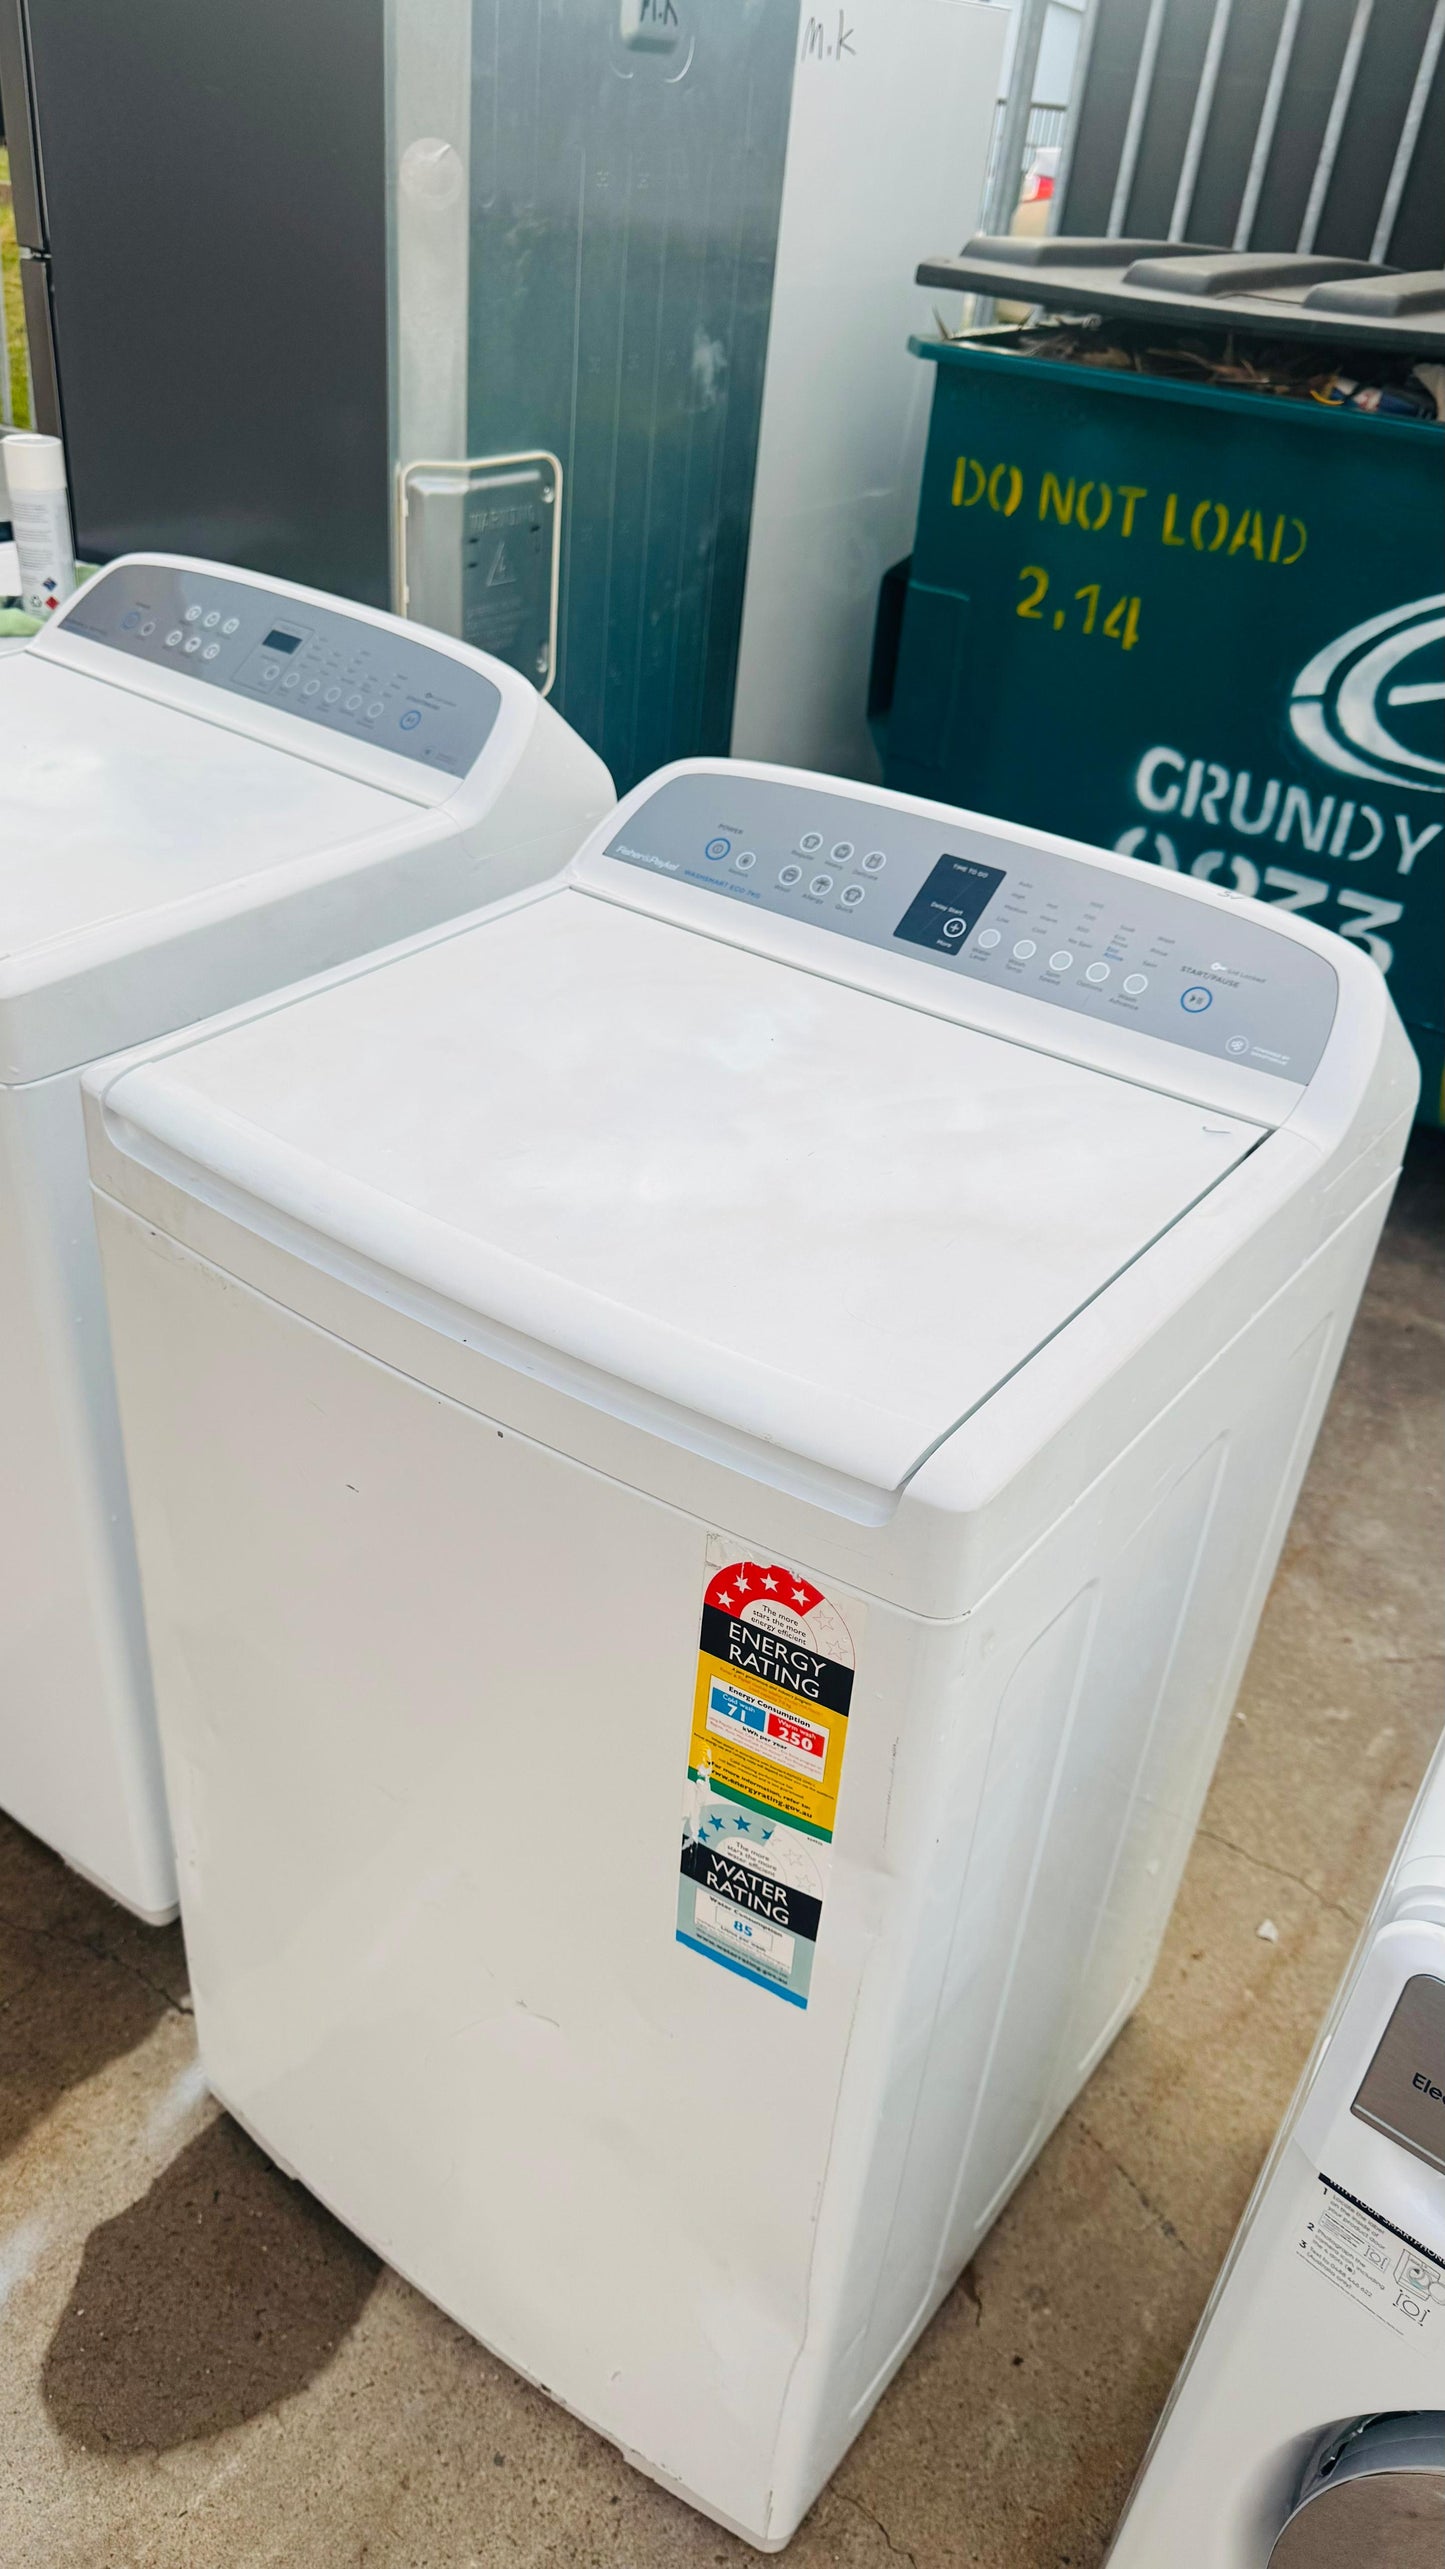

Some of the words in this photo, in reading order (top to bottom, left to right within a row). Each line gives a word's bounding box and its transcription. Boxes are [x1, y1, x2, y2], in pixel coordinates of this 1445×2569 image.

[952, 456, 1023, 517] DO
[1039, 471, 1147, 538] NOT
[1162, 493, 1307, 565] LOAD
[1135, 746, 1444, 876] GRUNDY
[717, 822, 744, 836] POWER
[1180, 965, 1240, 988] START/PAUSE
[753, 1610, 770, 1622] stars
[772, 1617, 784, 1627] the
[786, 1624, 807, 1638] more
[762, 1604, 777, 1616] The
[778, 1612, 799, 1627] more
[751, 1617, 776, 1632] energy
[777, 1628, 807, 1646] efficient
[728, 1621, 826, 1677] ENERGY
[728, 1643, 820, 1698] RATING
[722, 1694, 738, 1706] Cold
[739, 1701, 756, 1713] wash
[726, 1703, 746, 1722] 71
[728, 1685, 756, 1705] Energy
[757, 1700, 811, 1728] Consumption
[742, 1726, 759, 1737] kWh
[759, 1733, 773, 1744] per
[772, 1740, 788, 1750] year
[777, 1718, 799, 1731] Warm
[799, 1727, 817, 1740] wash
[778, 1728, 813, 1751] 250
[722, 1766, 740, 1776] more
[736, 1841, 749, 1852] The
[711, 1854, 788, 1906] WATER
[706, 1870, 790, 1925] RATING
[709, 1896, 732, 1912] Water
[733, 1920, 753, 1937] 85
[1323, 2187, 1328, 2195] 1
[1307, 2222, 1315, 2232] 2
[1299, 2239, 1307, 2249] 3
